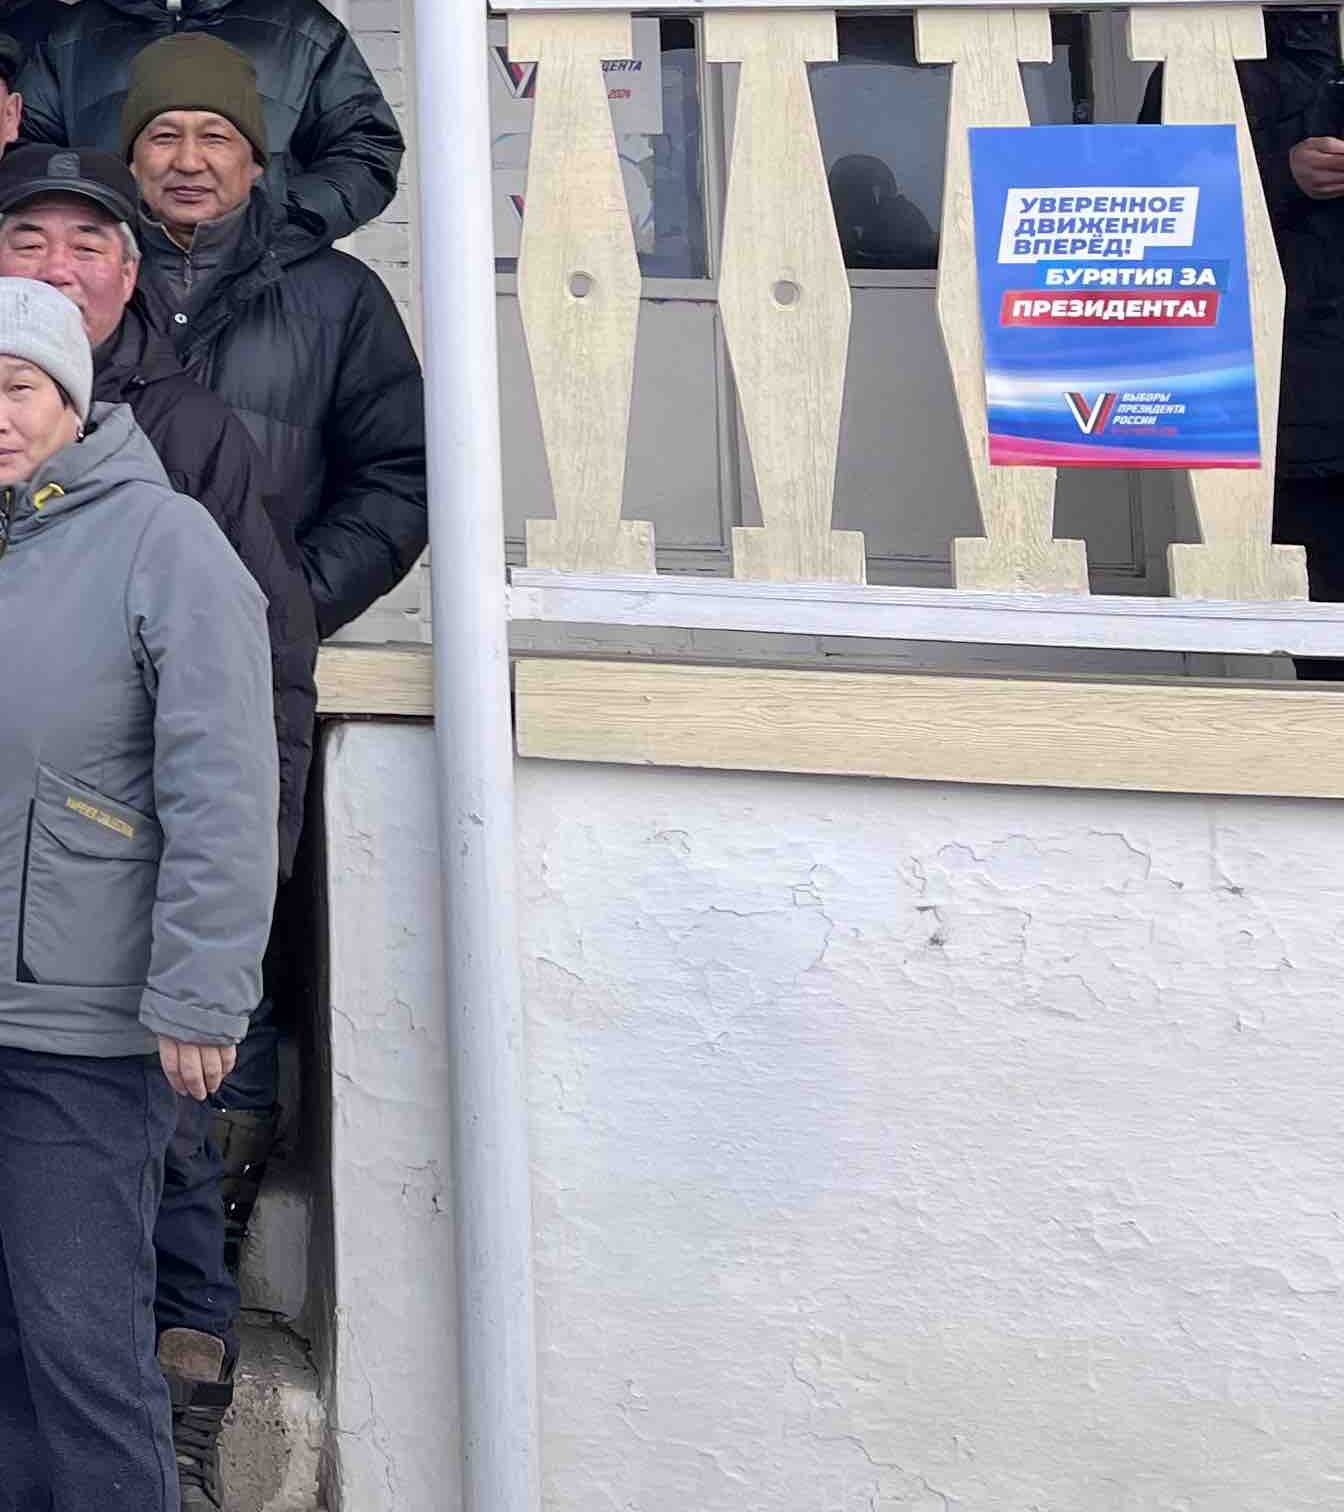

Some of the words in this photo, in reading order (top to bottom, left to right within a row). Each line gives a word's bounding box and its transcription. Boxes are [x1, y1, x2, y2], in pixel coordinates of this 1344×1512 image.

[1019, 196, 1185, 215] УВЕРЕННОЕ
[1014, 217, 1176, 238] ДВИЖЕНИЕ
[1013, 234, 1132, 258] ВПЕРЁД!
[1045, 267, 1173, 287] БУРЯТИЯ
[1178, 267, 1217, 287] ЗА
[1012, 299, 1208, 321] ПРЕЗИДЕНТА!
[1122, 392, 1170, 402] ВЫБОРЫ
[1116, 404, 1186, 415] ПРЕЗИДЕНТА
[1112, 415, 1158, 425] РОССИИ
